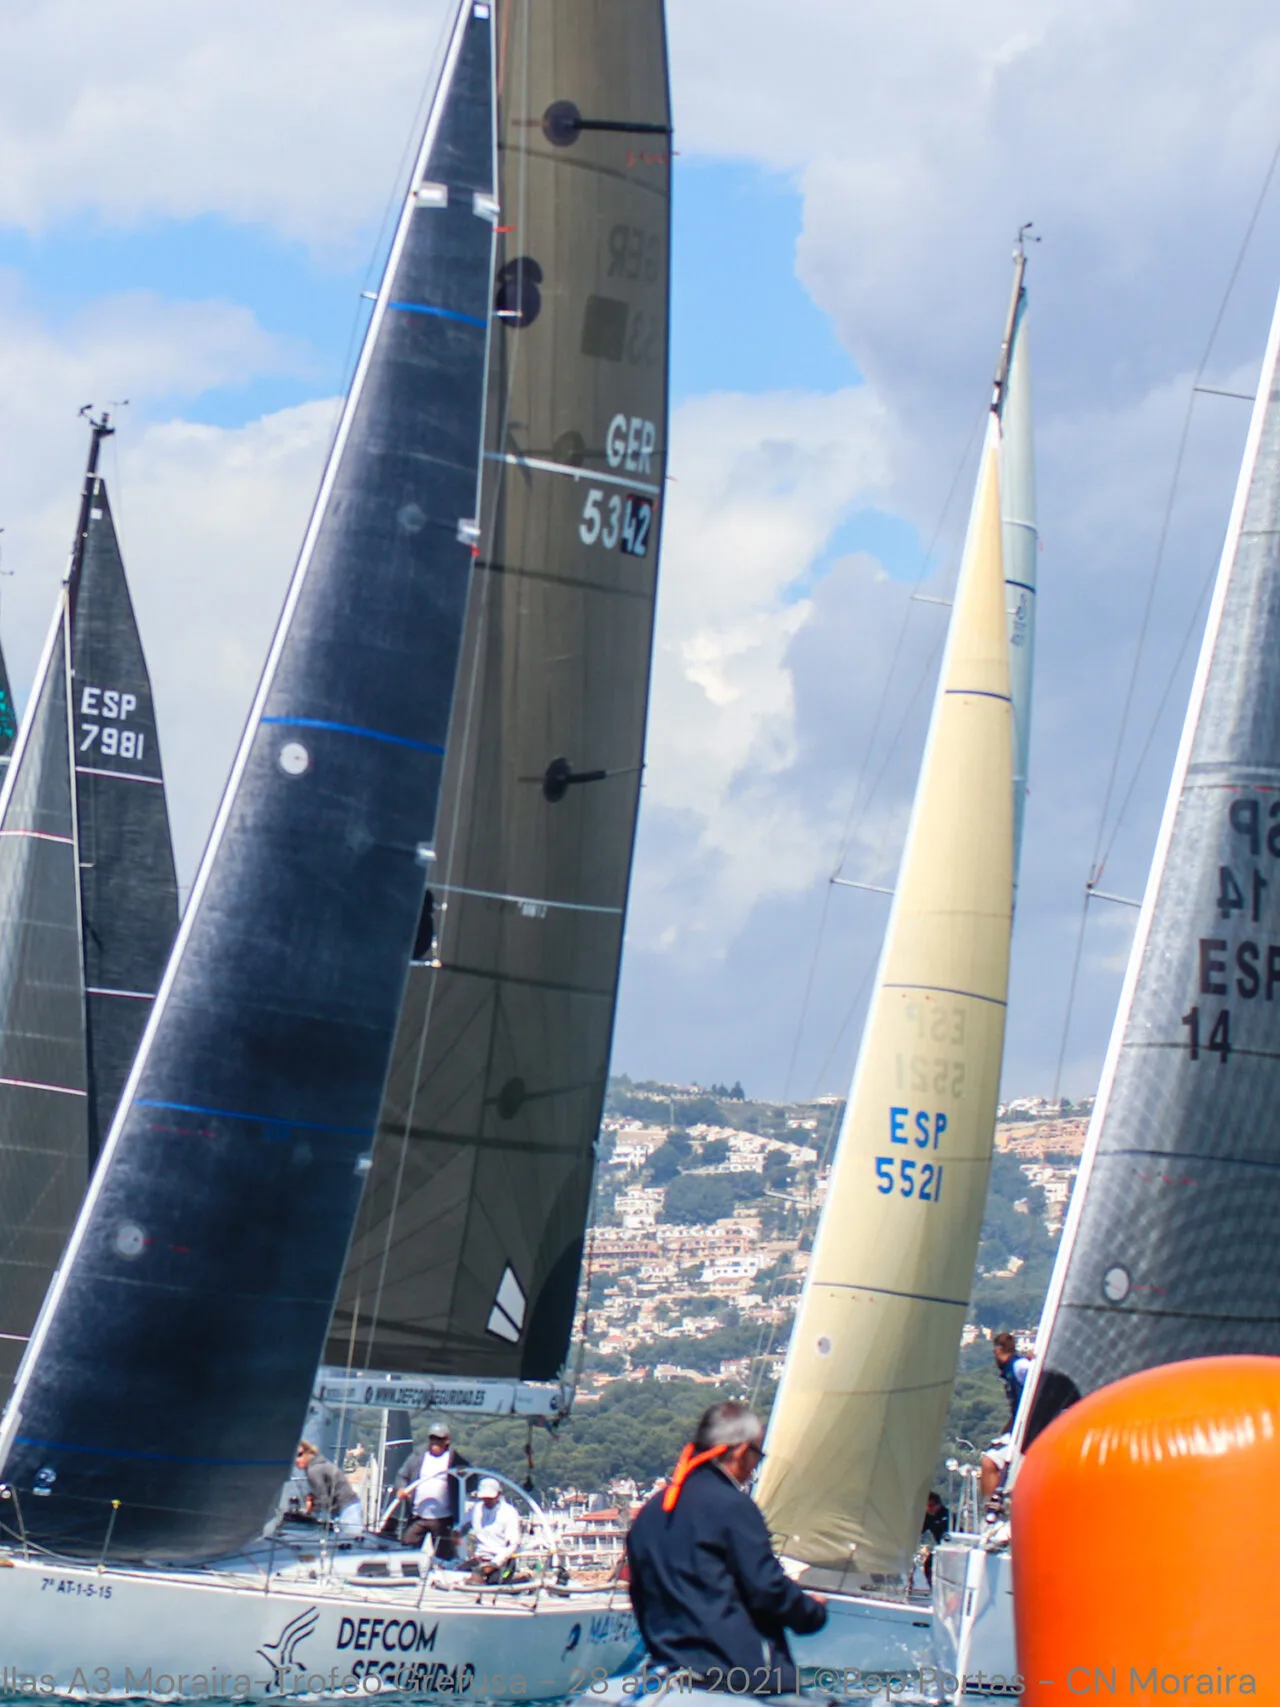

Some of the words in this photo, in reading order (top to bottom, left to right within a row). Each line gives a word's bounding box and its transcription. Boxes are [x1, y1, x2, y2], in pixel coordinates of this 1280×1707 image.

[606, 413, 656, 475] GER
[579, 488, 652, 556] 5342
[80, 686, 137, 720] ESP
[80, 723, 144, 760] 7981
[1181, 1005, 1233, 1064] 14
[889, 1106, 948, 1150] ESP
[875, 1156, 944, 1203] 5521
[336, 1617, 440, 1652] DEFCOM
[351, 1660, 476, 1694] SEGURIDAD
